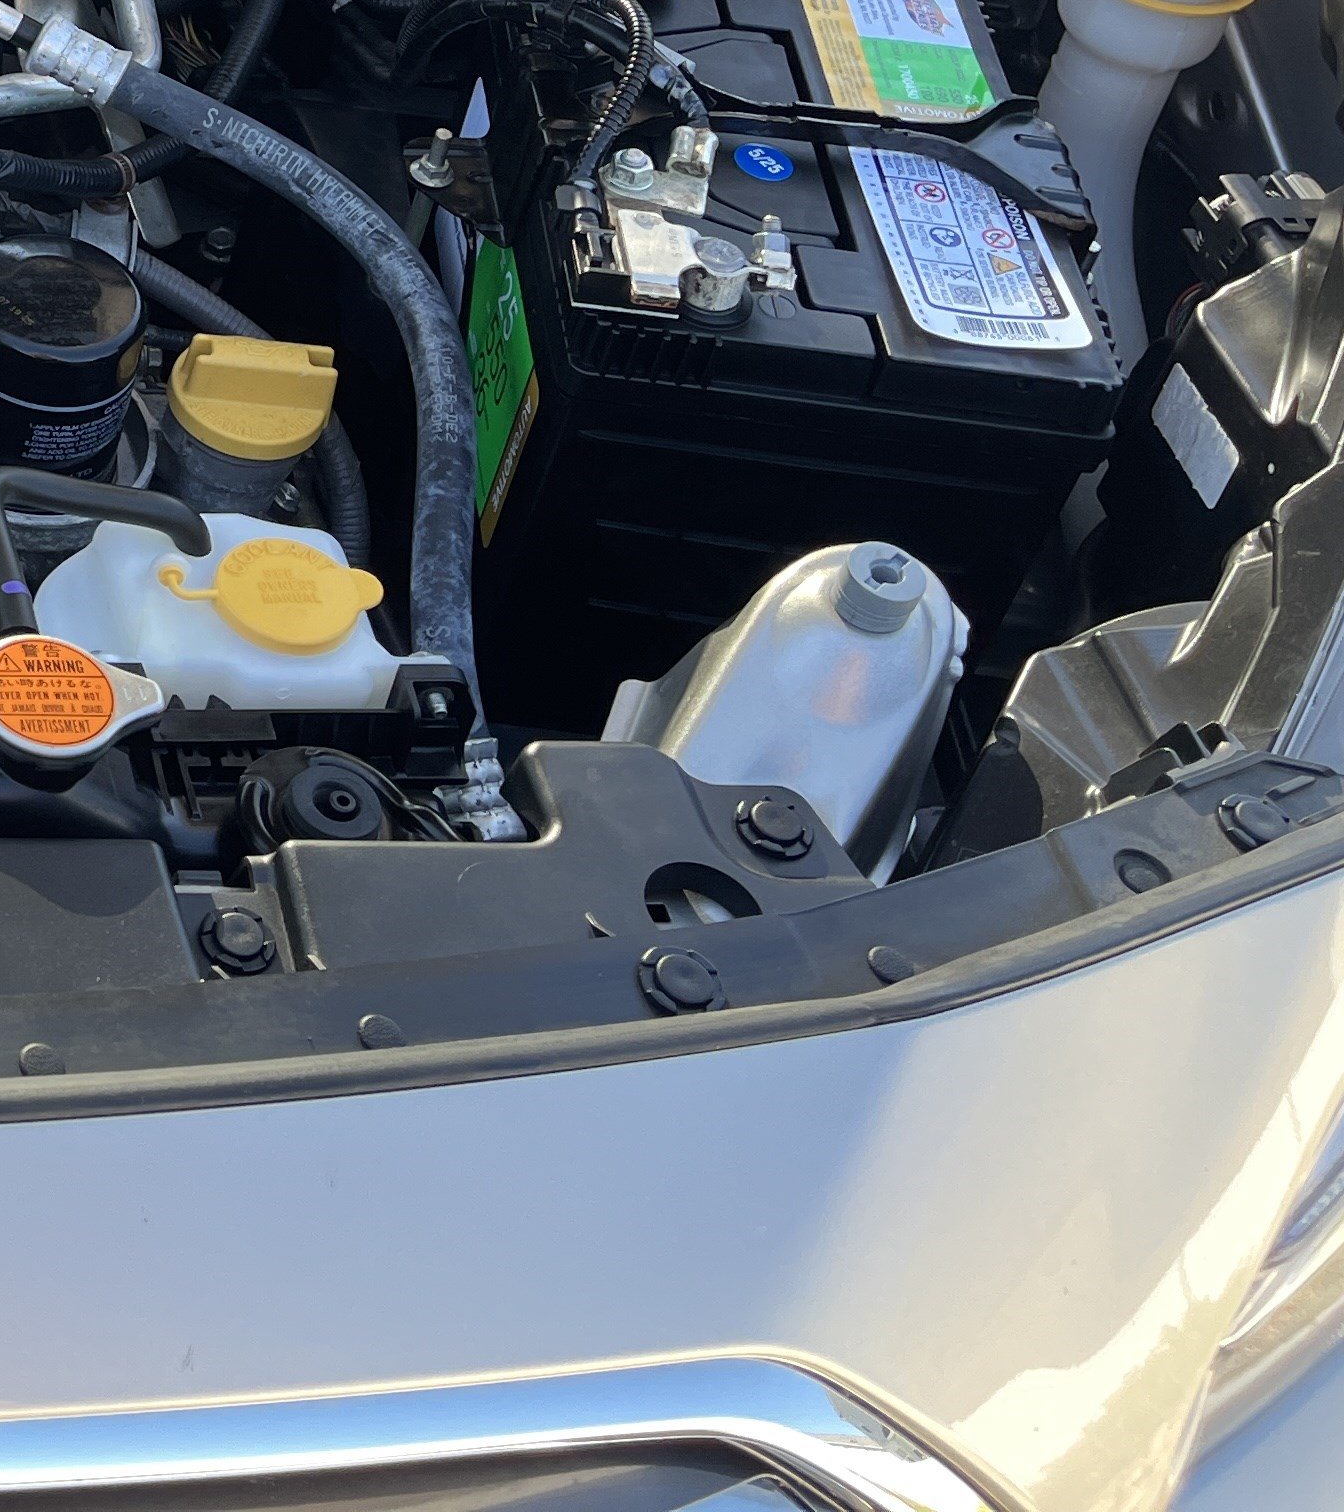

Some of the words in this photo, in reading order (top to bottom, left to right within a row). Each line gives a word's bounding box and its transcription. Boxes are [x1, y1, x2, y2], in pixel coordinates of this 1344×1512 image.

[747, 147, 786, 175] 5/25
[1002, 197, 1031, 241] POISON
[497, 271, 518, 342] 25
[486, 311, 508, 406] 550
[492, 395, 532, 512] AUTOMOTIVE
[223, 540, 336, 577] COOLANT
[21, 644, 62, 658] 警告
[23, 659, 85, 674] WARNING
[26, 691, 50, 700] OPEN
[53, 691, 80, 701] WHEN
[20, 719, 92, 734] AVERTISSMENT
